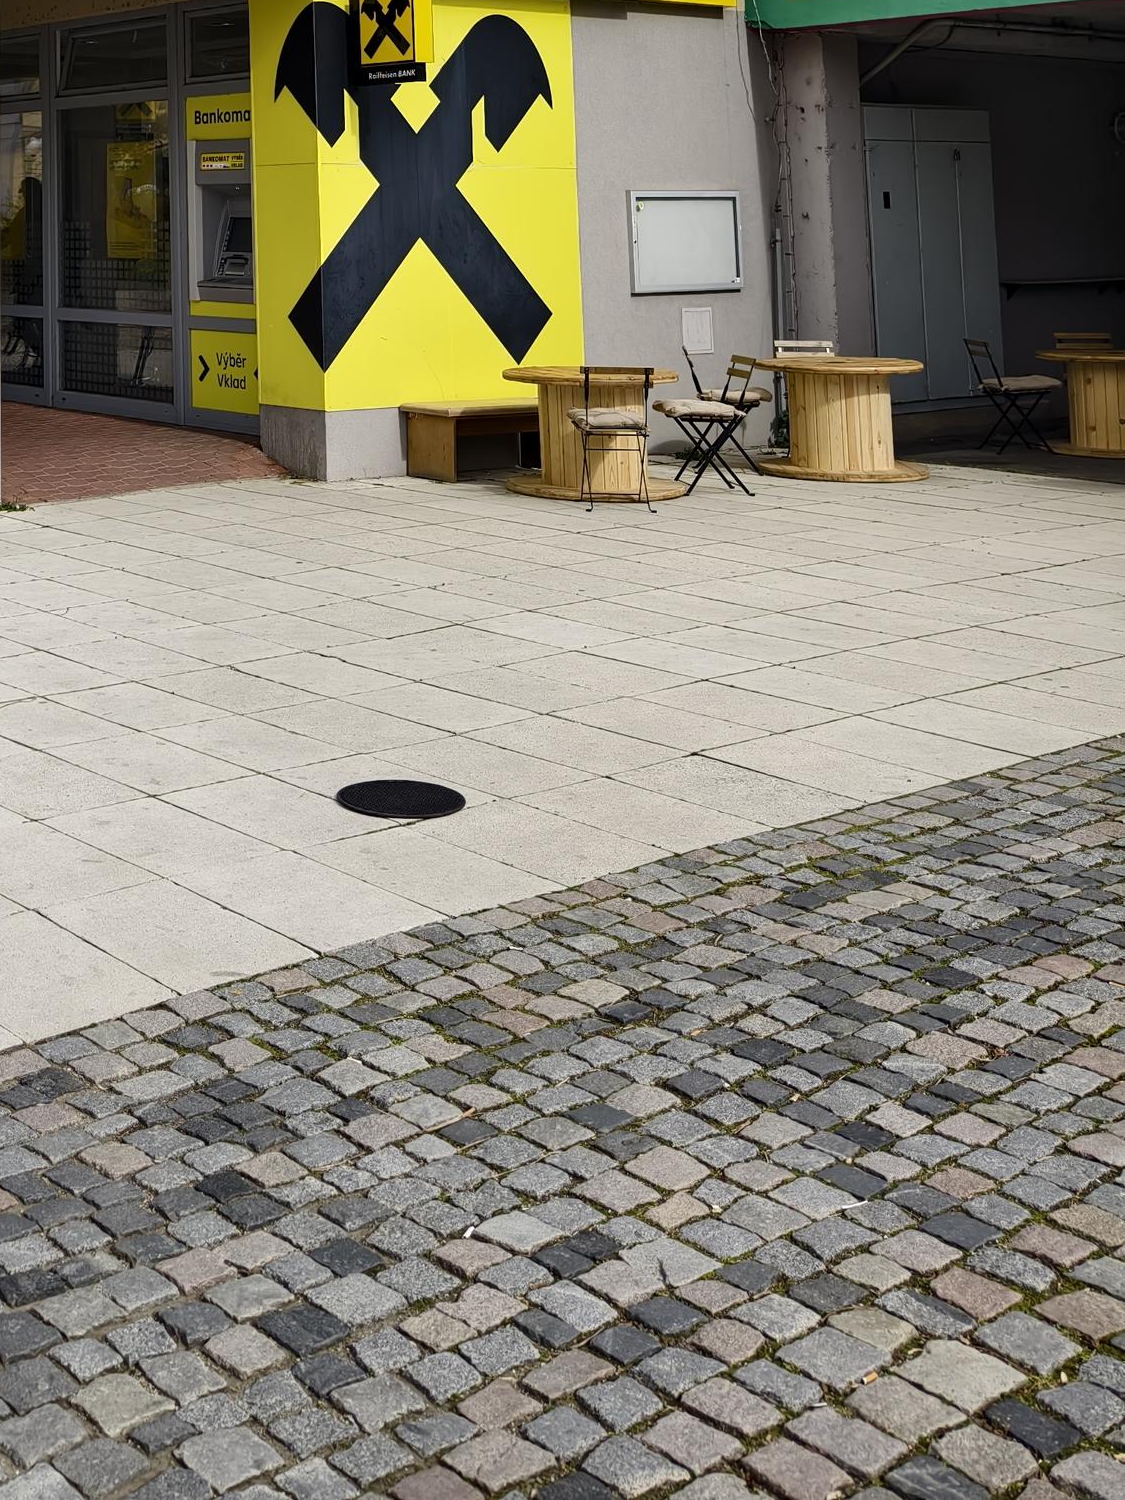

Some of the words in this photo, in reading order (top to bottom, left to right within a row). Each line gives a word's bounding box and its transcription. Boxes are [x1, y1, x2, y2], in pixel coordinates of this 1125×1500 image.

[368, 70, 397, 80] Raiffeisen
[397, 69, 416, 77] BANK
[193, 109, 252, 125] Bankoma
[216, 351, 247, 370] Výběr
[216, 372, 247, 390] Vklad
